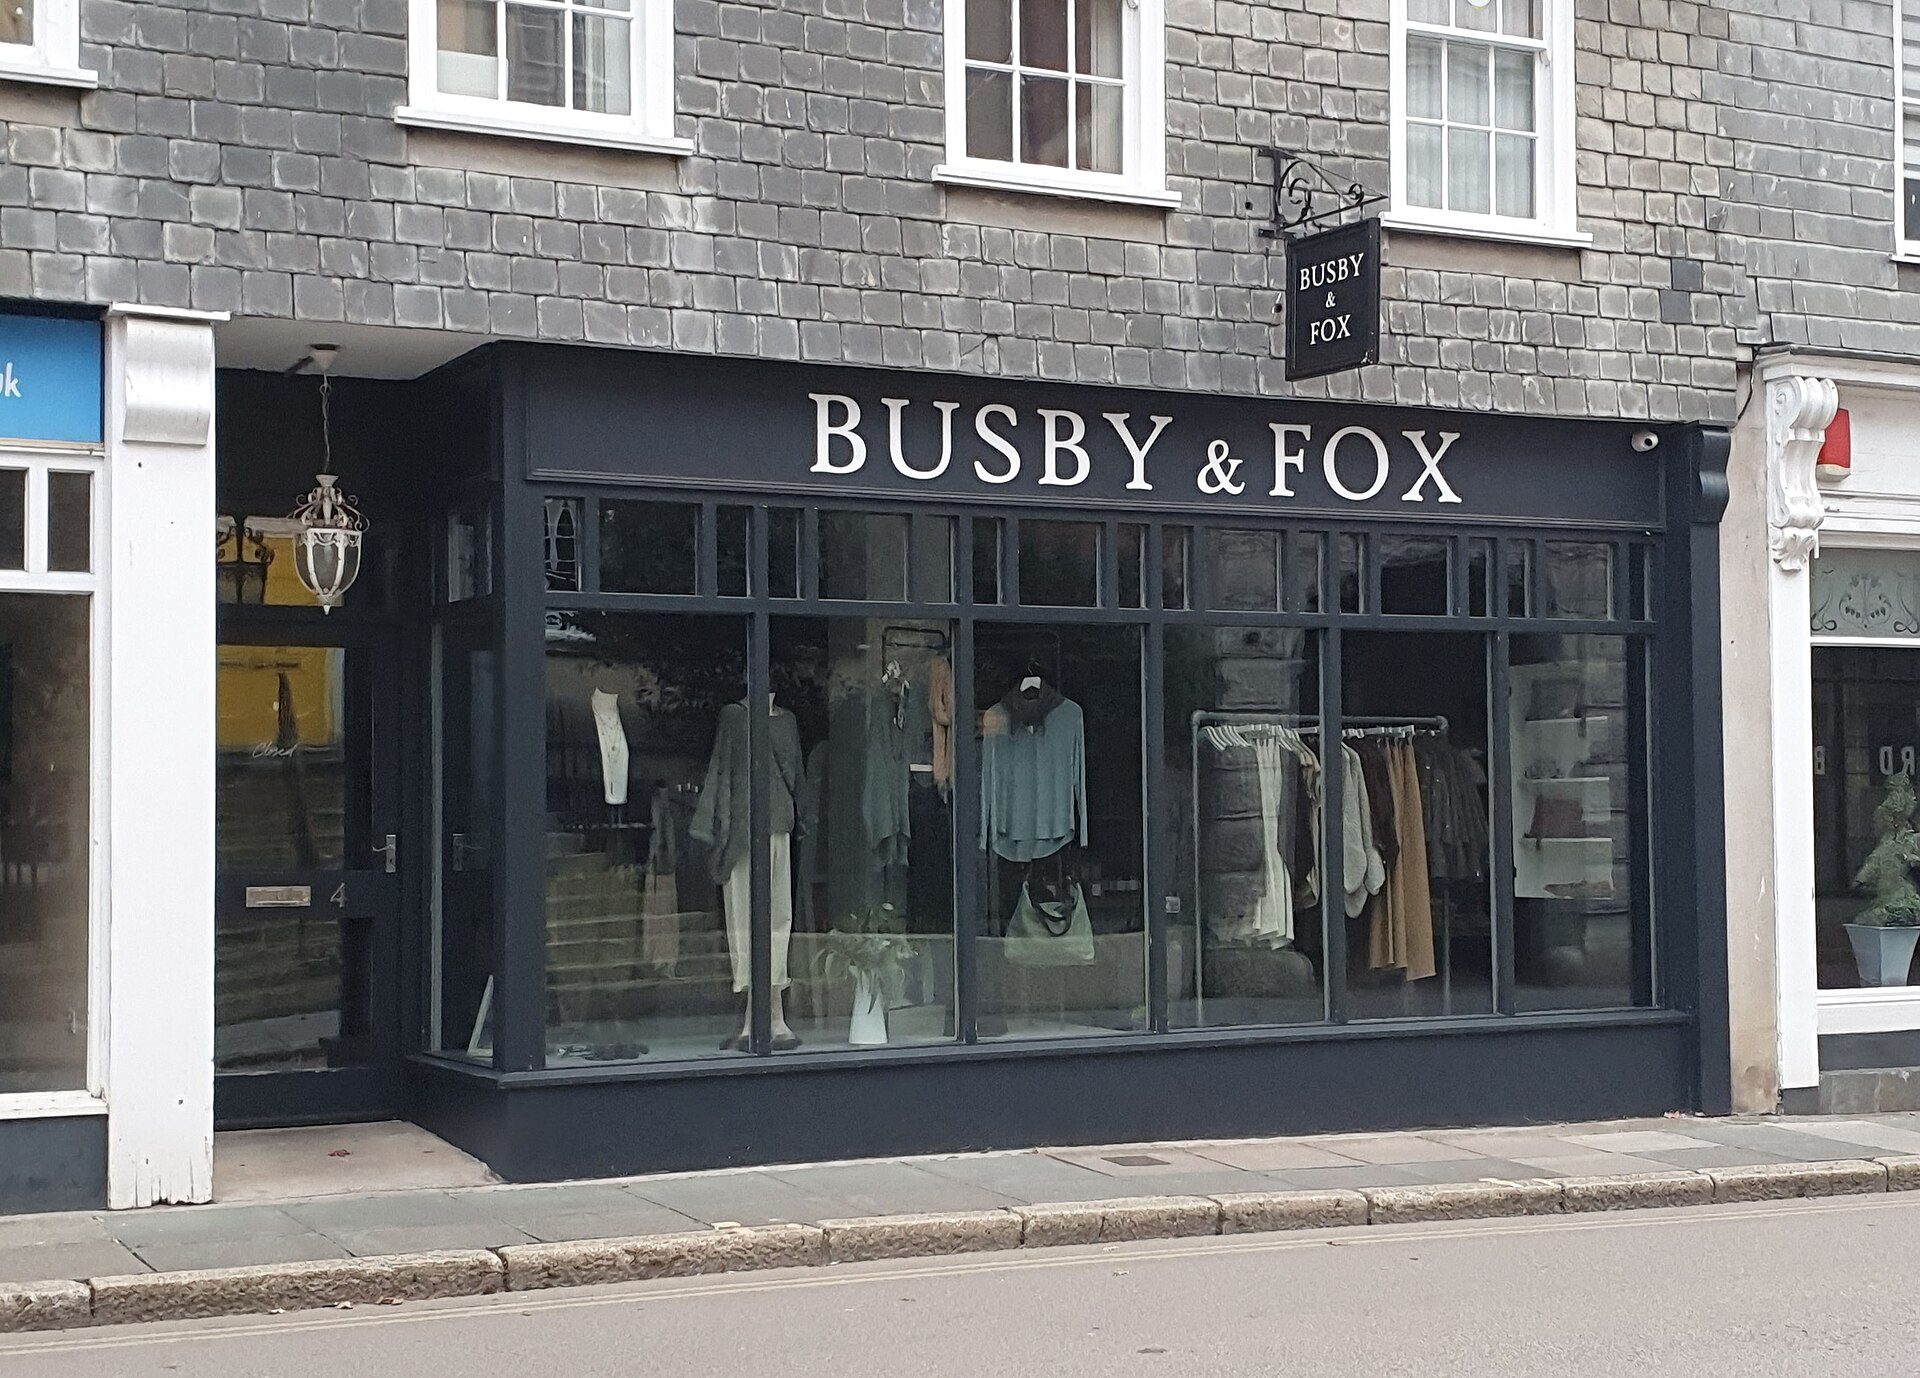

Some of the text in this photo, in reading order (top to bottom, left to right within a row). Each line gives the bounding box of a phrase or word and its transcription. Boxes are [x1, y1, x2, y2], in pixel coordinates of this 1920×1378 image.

[1300, 253, 1364, 291] BUSBY
[1325, 291, 1336, 309] &
[1309, 314, 1351, 346] FOX
[807, 392, 1463, 504] BUSBY & FOX
[330, 882, 347, 908] 4
